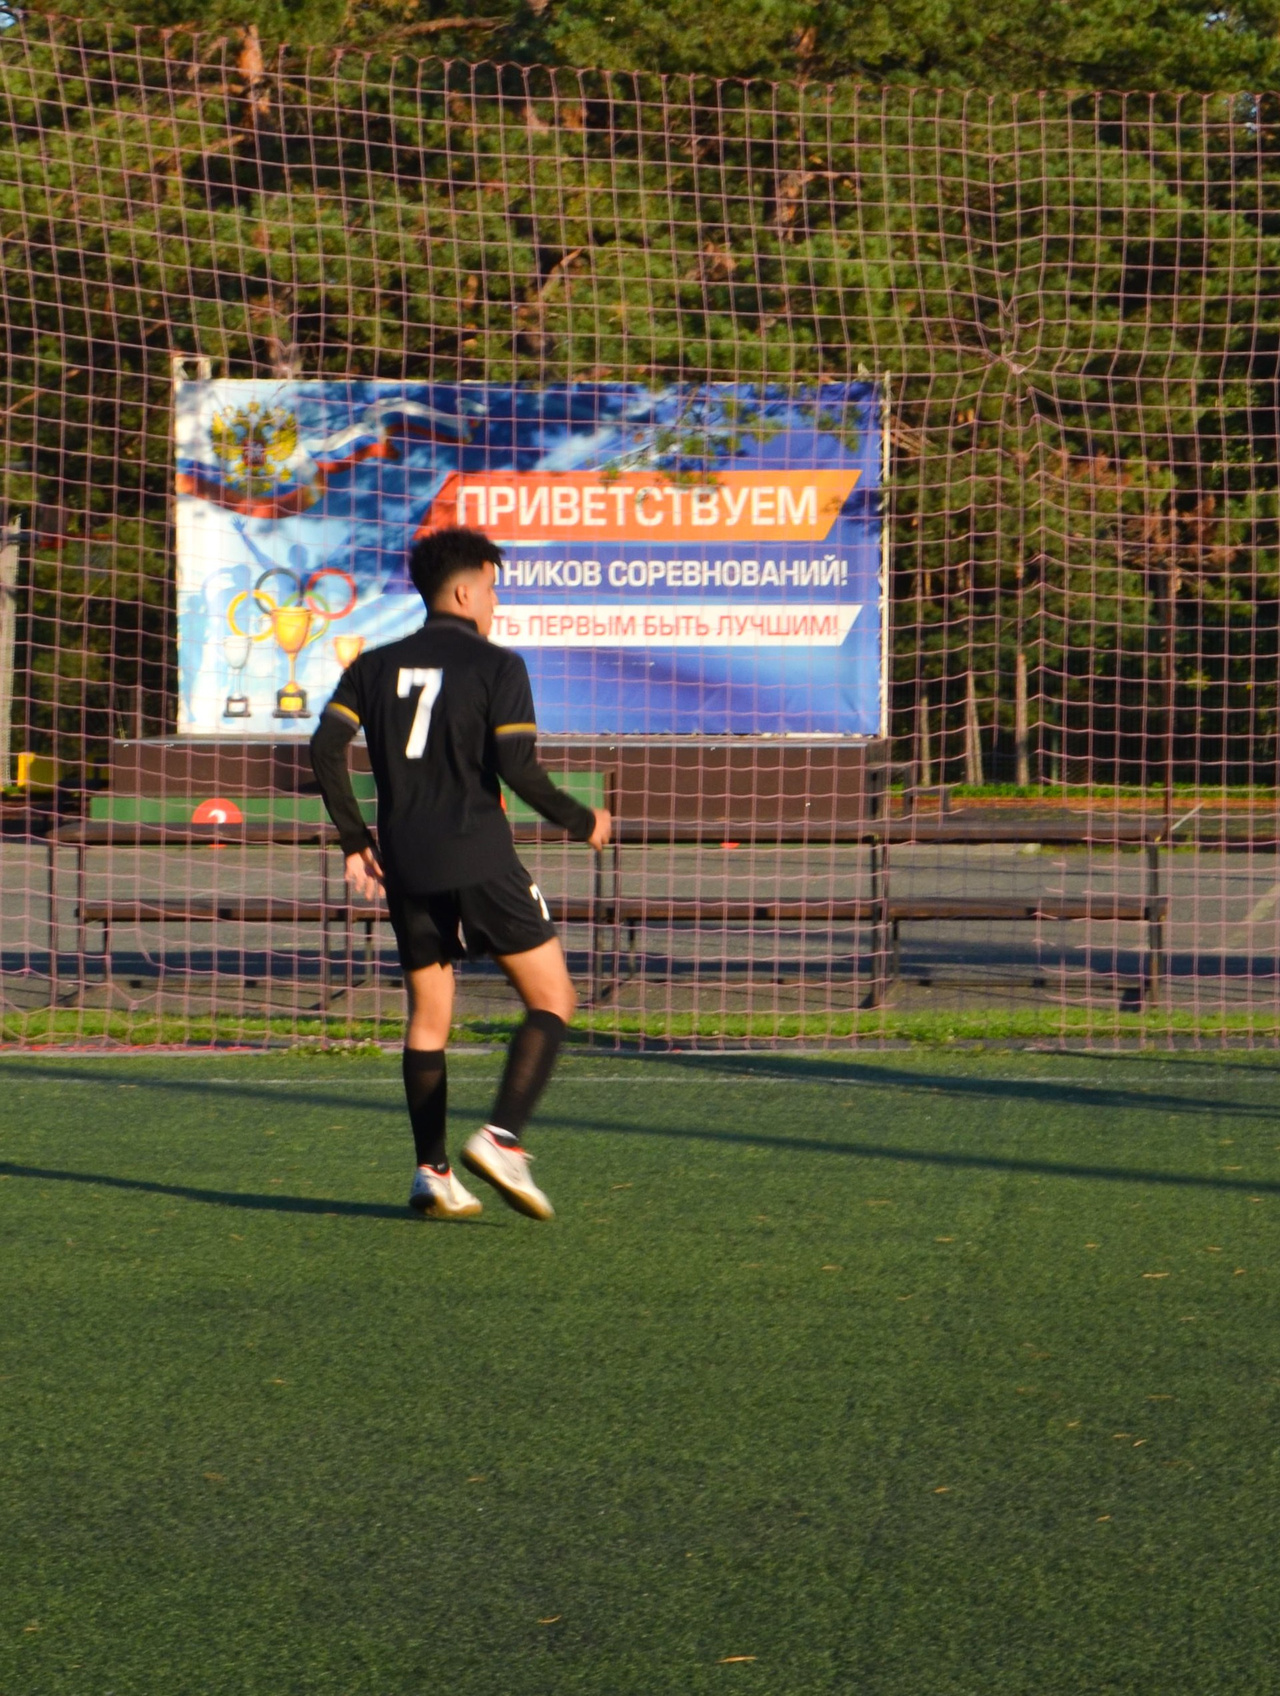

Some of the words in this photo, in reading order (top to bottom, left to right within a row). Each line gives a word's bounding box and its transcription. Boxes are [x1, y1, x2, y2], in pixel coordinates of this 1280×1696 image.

[456, 485, 817, 527] ПРИВЕТСТВУЕМ
[607, 554, 848, 587] СОРЕВНОВАНИЙ!
[528, 614, 636, 636] ПЕРВЫМ
[643, 614, 710, 636] БЫТЬ
[716, 614, 839, 637] ЛУЧШИМ!
[396, 667, 444, 760] 7
